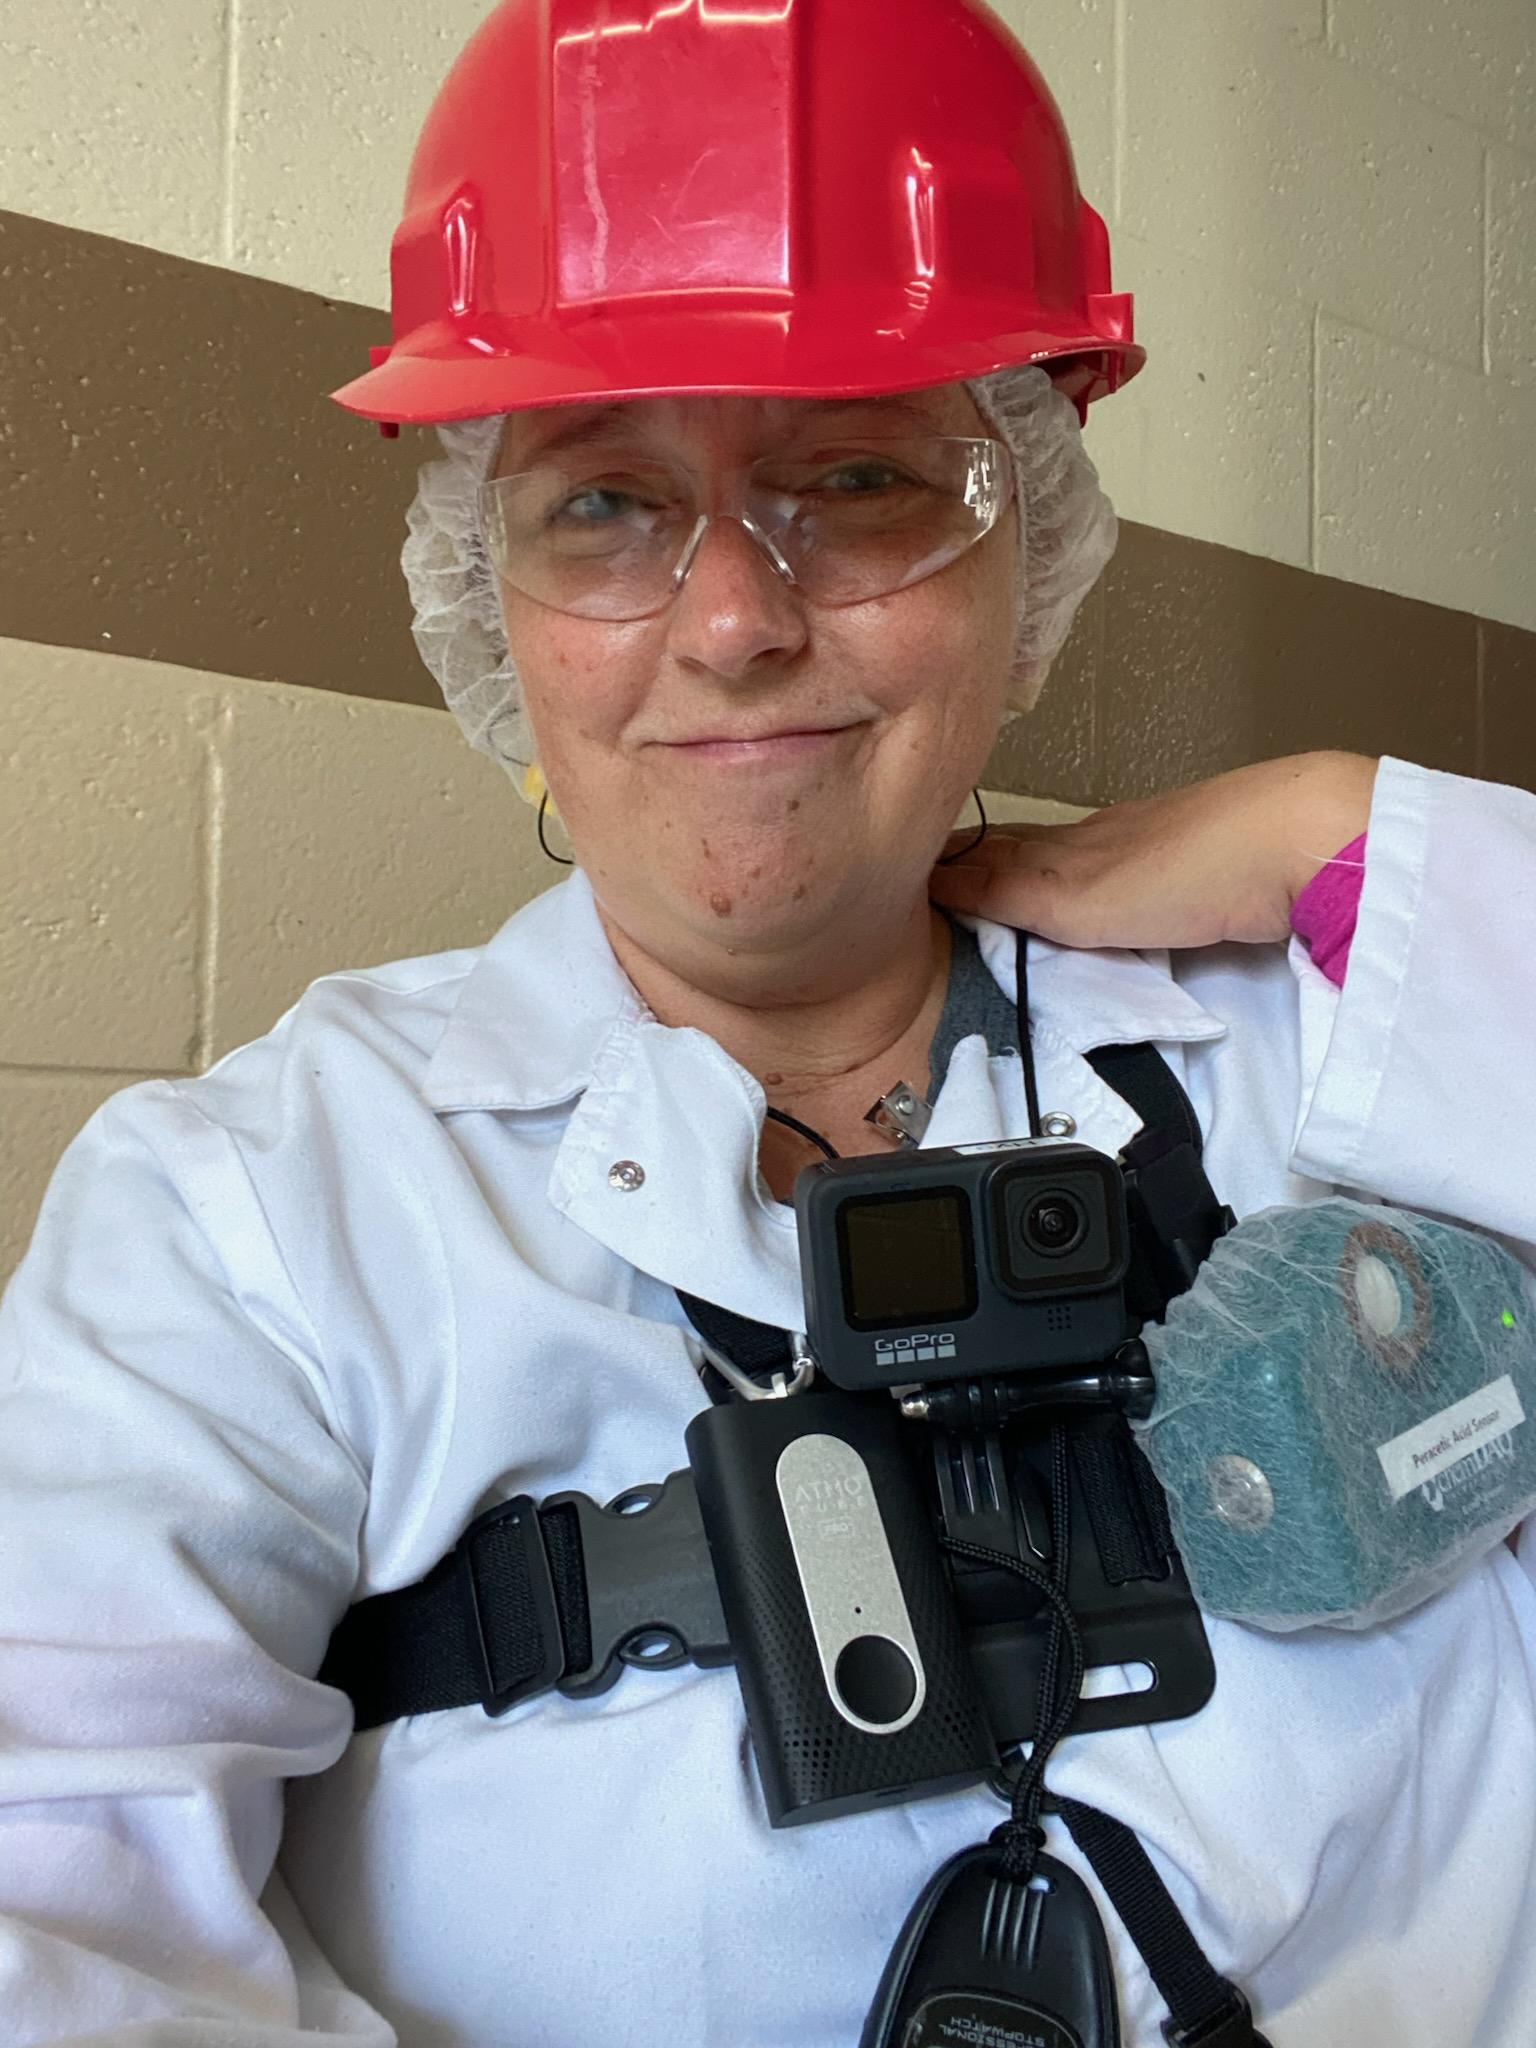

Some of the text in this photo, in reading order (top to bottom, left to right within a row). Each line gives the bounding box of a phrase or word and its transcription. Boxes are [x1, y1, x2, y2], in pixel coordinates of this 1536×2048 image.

[874, 1333, 955, 1352] GoPro
[1411, 1409, 1500, 1469] Peracetic Acid Sensor
[795, 1477, 862, 1503] ATMO
[938, 2023, 1036, 2048] ESSIONAL
[950, 2016, 1046, 2048] STOPWATCH
